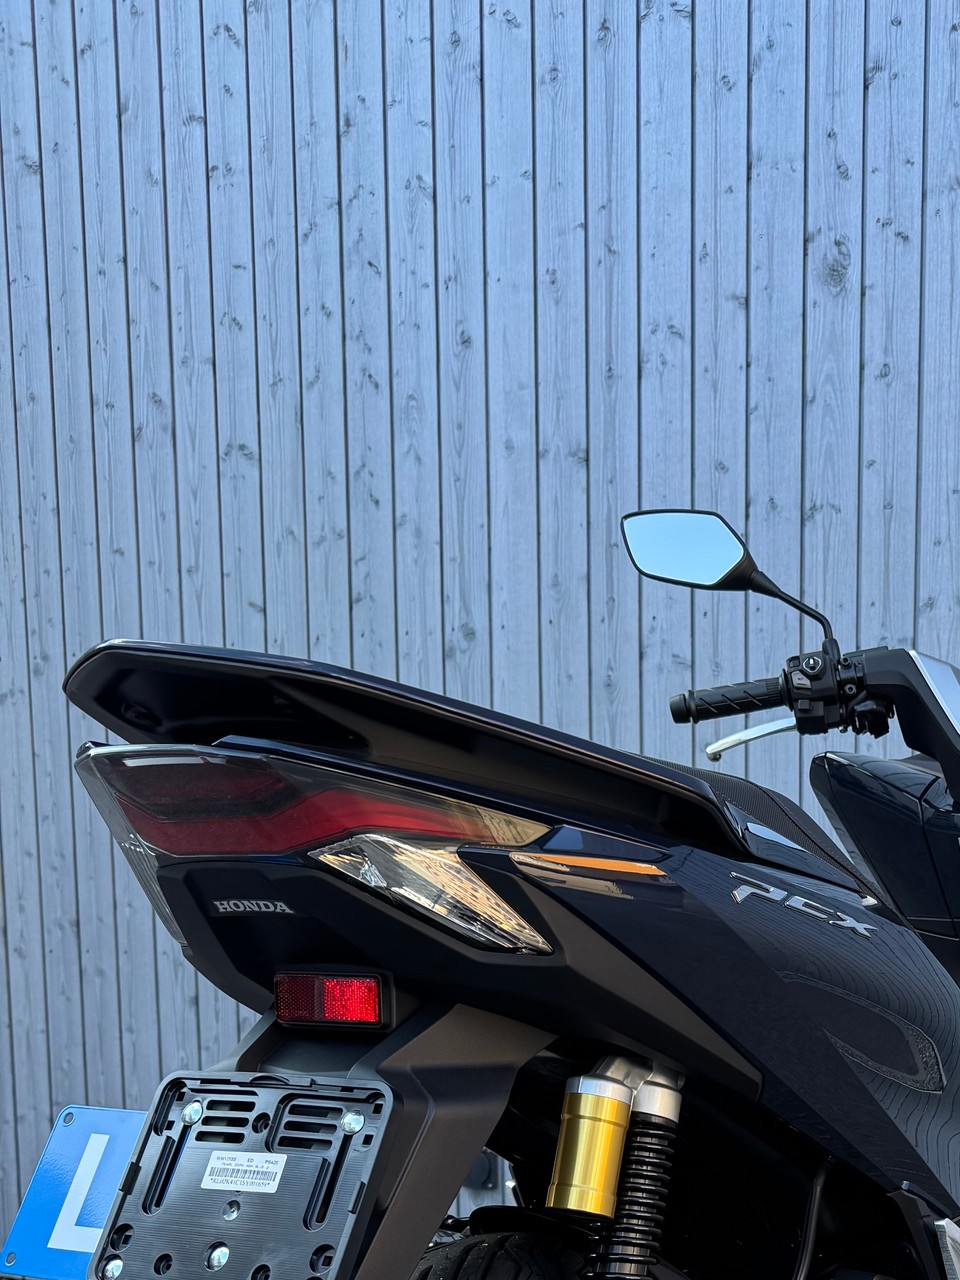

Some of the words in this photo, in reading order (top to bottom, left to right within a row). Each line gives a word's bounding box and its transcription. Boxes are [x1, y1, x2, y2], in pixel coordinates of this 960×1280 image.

[213, 900, 294, 914] HONDA
[729, 871, 879, 940] PCX
[47, 1133, 110, 1253] L
